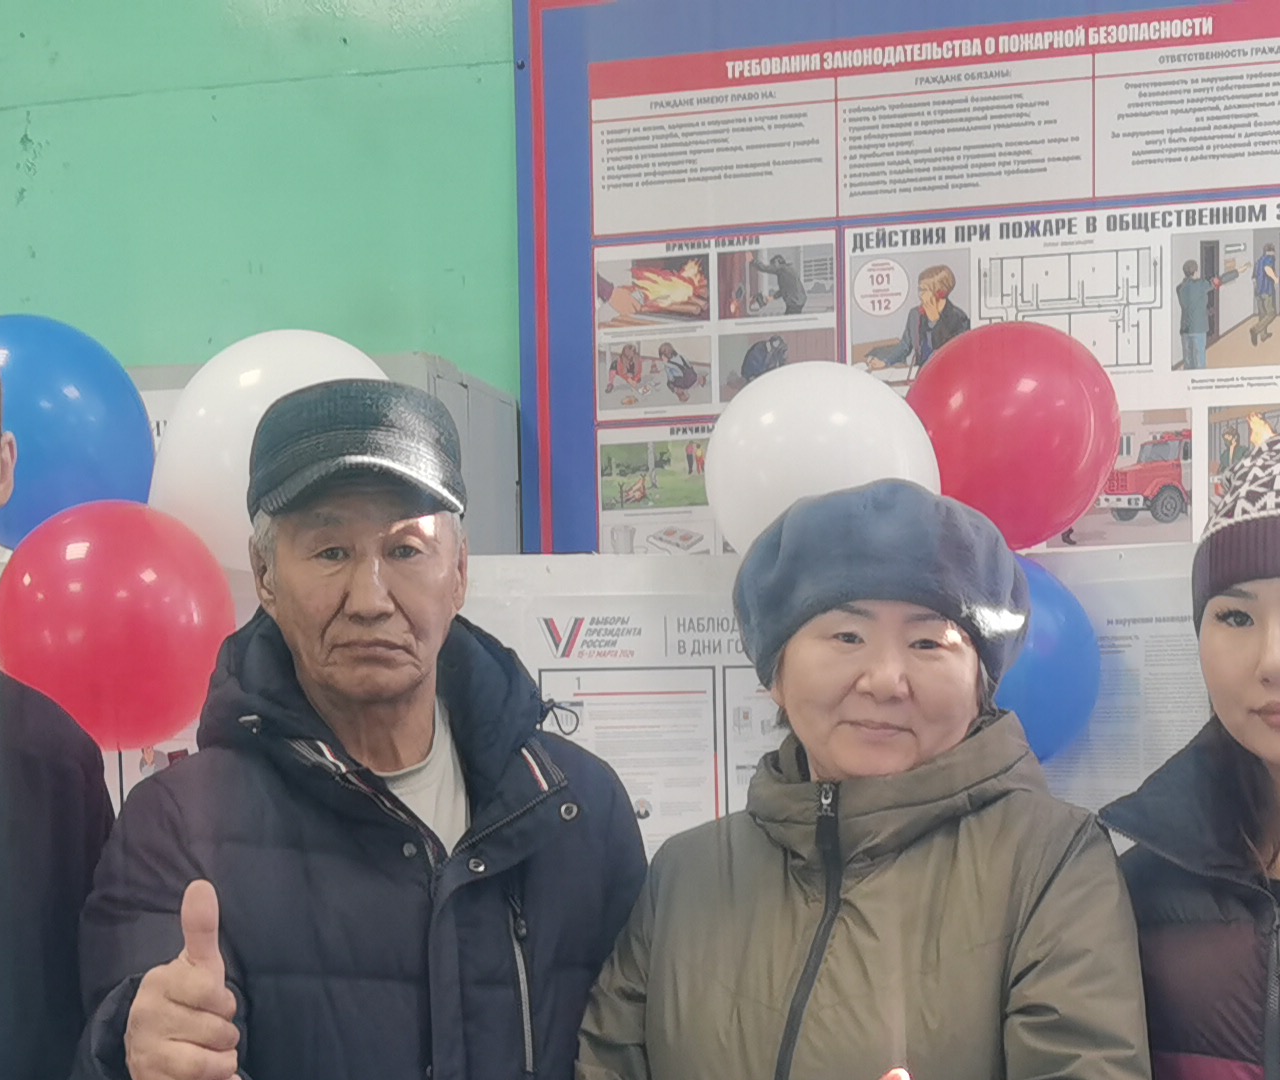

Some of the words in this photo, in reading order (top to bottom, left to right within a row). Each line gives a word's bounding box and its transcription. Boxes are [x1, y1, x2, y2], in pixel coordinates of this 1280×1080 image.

[725, 53, 821, 80] ТРЕБОВАНИЯ
[823, 38, 982, 71] ЗАКОНОДАТЕЛЬСТВА
[984, 37, 996, 55] О
[999, 25, 1086, 54] ПОЖАРНОЙ
[1088, 16, 1214, 45] БЕЗОПАСНОСТИ
[1158, 48, 1249, 65] ОТВЕТСТВЕННОСТЬ
[914, 72, 963, 86] ГРАЖДАНЕ
[964, 69, 1012, 82] ОБЯЗАНЫ:
[649, 98, 694, 111] ГРАЖДАНЕ
[696, 95, 729, 107] ИМЕЮТ
[730, 92, 760, 104] ПРАВО
[761, 91, 777, 101] НА:
[851, 226, 946, 253] ДЕЙСТВИЯ
[954, 222, 991, 243] ПРИ
[999, 217, 1078, 240] ПОЖАРЕ
[1085, 215, 1097, 233] В
[1105, 203, 1267, 232] ОБЩЕСТВЕННОМ
[714, 235, 761, 248] ПОЖАРОВ
[869, 273, 891, 286] 101
[870, 298, 891, 311] 112
[589, 616, 631, 626] ВЫБОРЫ
[584, 627, 642, 638] ПРЕЗИДЕНТА
[580, 639, 618, 649] РОССИИ
[677, 640, 687, 655] В
[690, 639, 721, 657] ДНИ
[574, 676, 582, 690] 1
